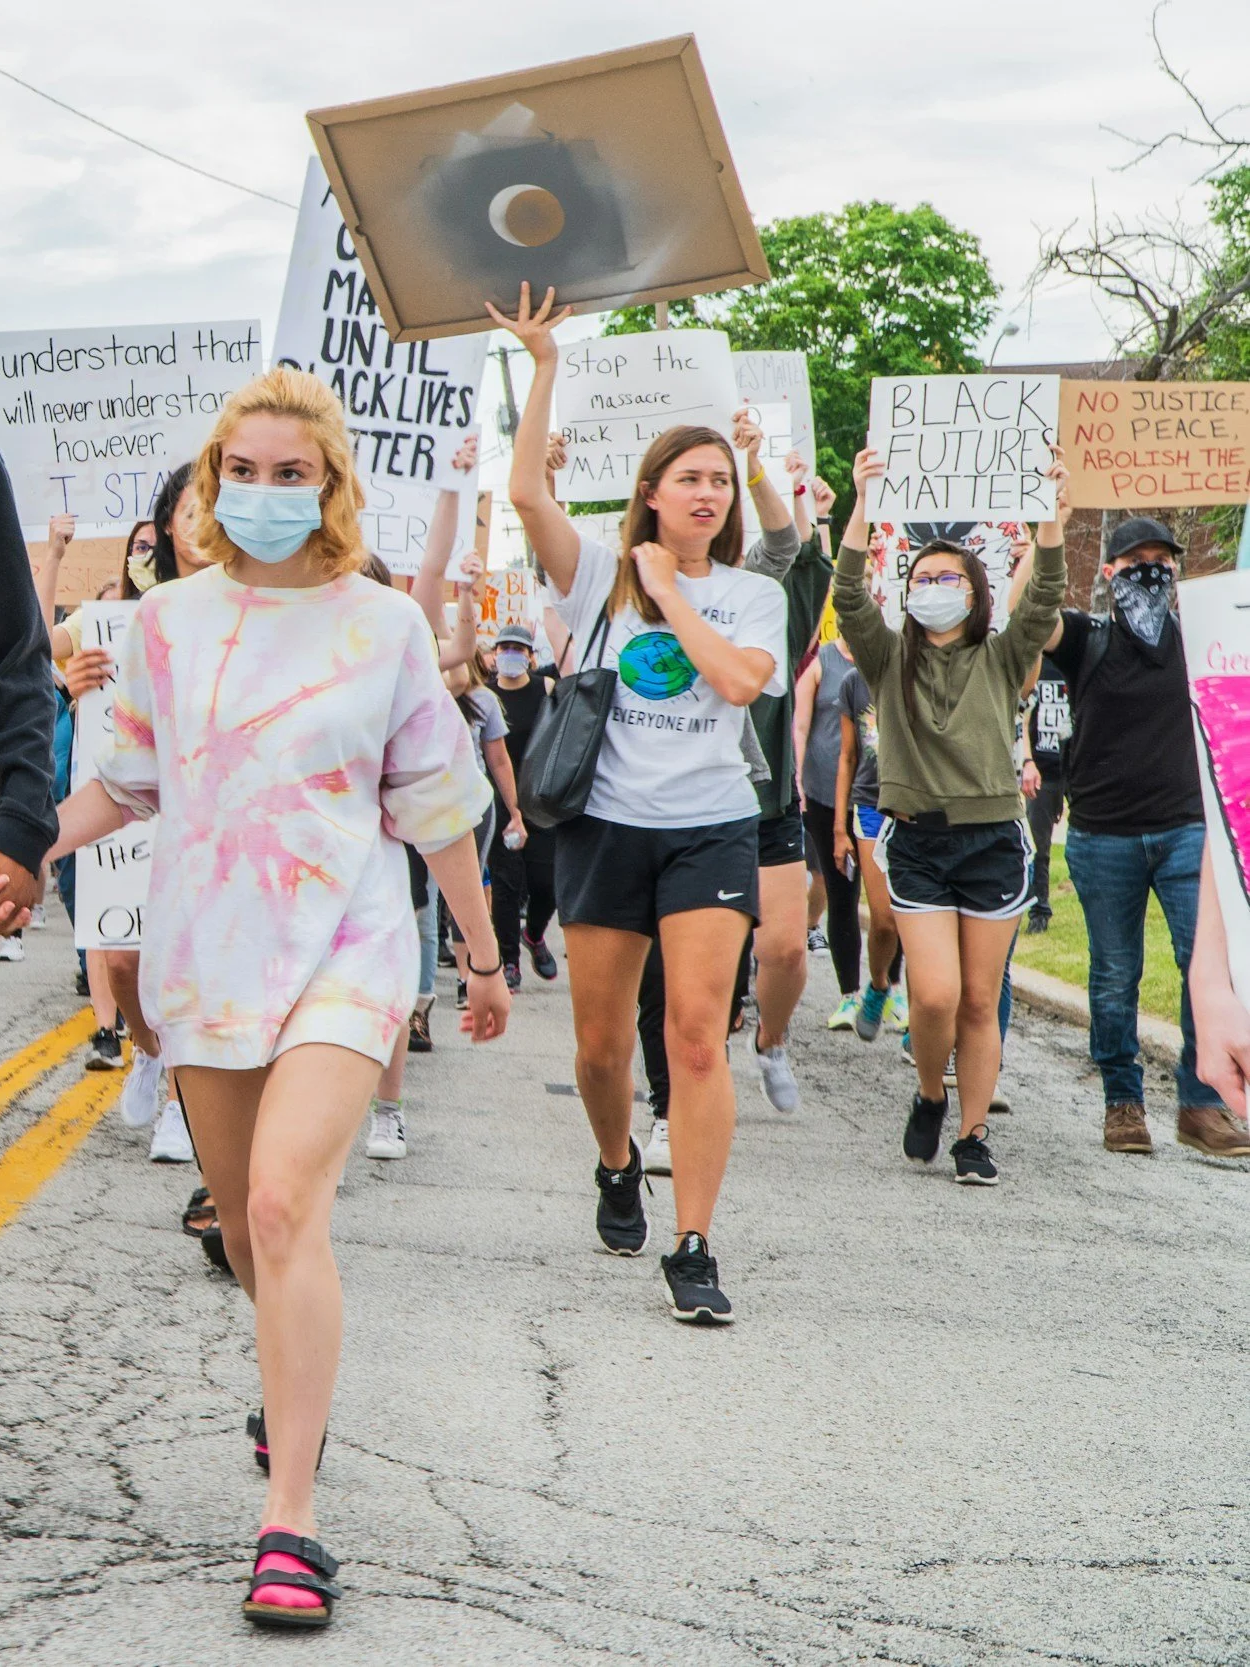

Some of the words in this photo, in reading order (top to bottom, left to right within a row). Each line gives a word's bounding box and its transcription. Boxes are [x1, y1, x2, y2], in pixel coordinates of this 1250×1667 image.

[1, 330, 178, 379] understand
[192, 325, 261, 364] that
[565, 348, 628, 379] Stop
[652, 344, 700, 373] the
[2, 390, 37, 426] will
[42, 397, 94, 425] never
[396, 375, 475, 429] LIVES
[892, 380, 1048, 428] BLACK
[1076, 390, 1119, 413] NO
[1131, 390, 1250, 415] JUSTICE,
[1075, 422, 1114, 446] NO
[1131, 418, 1239, 442] PEACE,
[886, 427, 1057, 476] FUTURES
[1083, 447, 1190, 471] ABOLISH
[1199, 446, 1246, 468] THE
[878, 473, 1049, 511] MATTER
[96, 614, 126, 646] IF
[612, 706, 689, 731] EVERYONE
